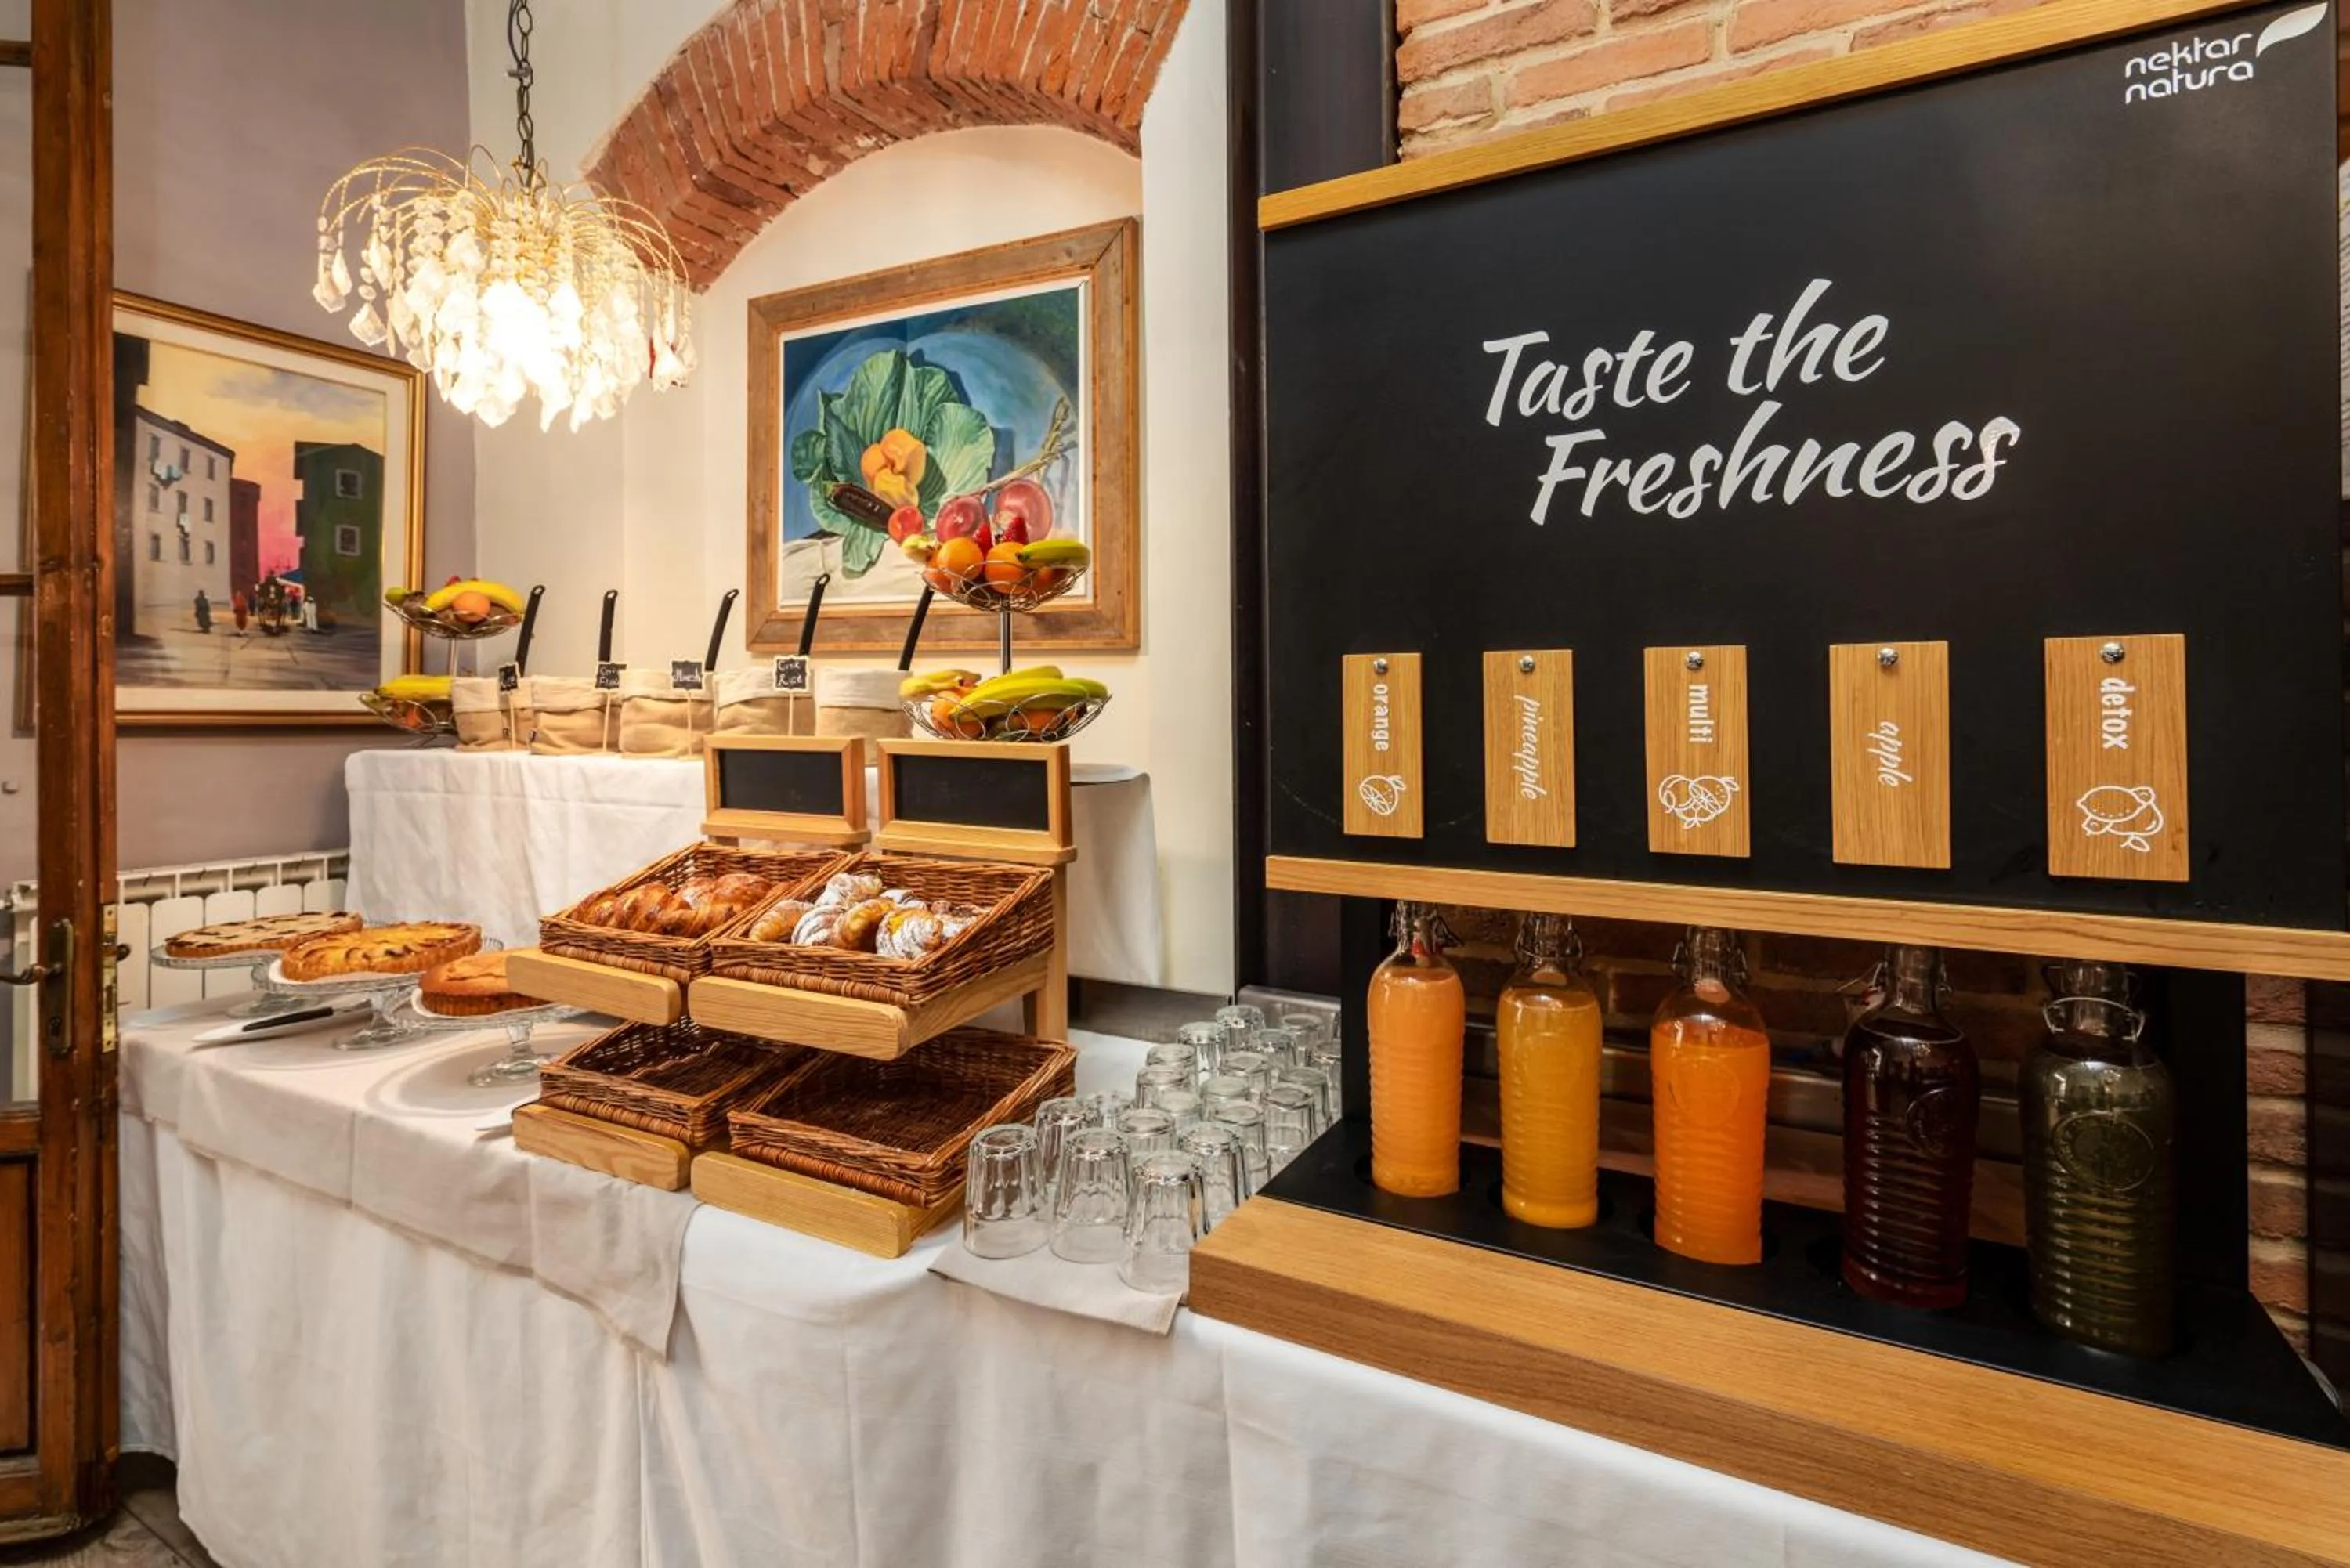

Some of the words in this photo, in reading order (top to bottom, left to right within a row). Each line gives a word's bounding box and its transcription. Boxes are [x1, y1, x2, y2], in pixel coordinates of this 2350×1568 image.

[2124, 33, 2253, 78] nektar
[2124, 61, 2254, 104] natura
[1482, 330, 1694, 427] Taste
[1727, 278, 1889, 396] the
[1529, 400, 2021, 526] Freshness
[1372, 683, 1390, 752] orange
[1512, 694, 1548, 800] pineapple
[1688, 684, 1715, 743] multi
[2099, 677, 2136, 750] detox
[1867, 721, 1913, 787] apple
